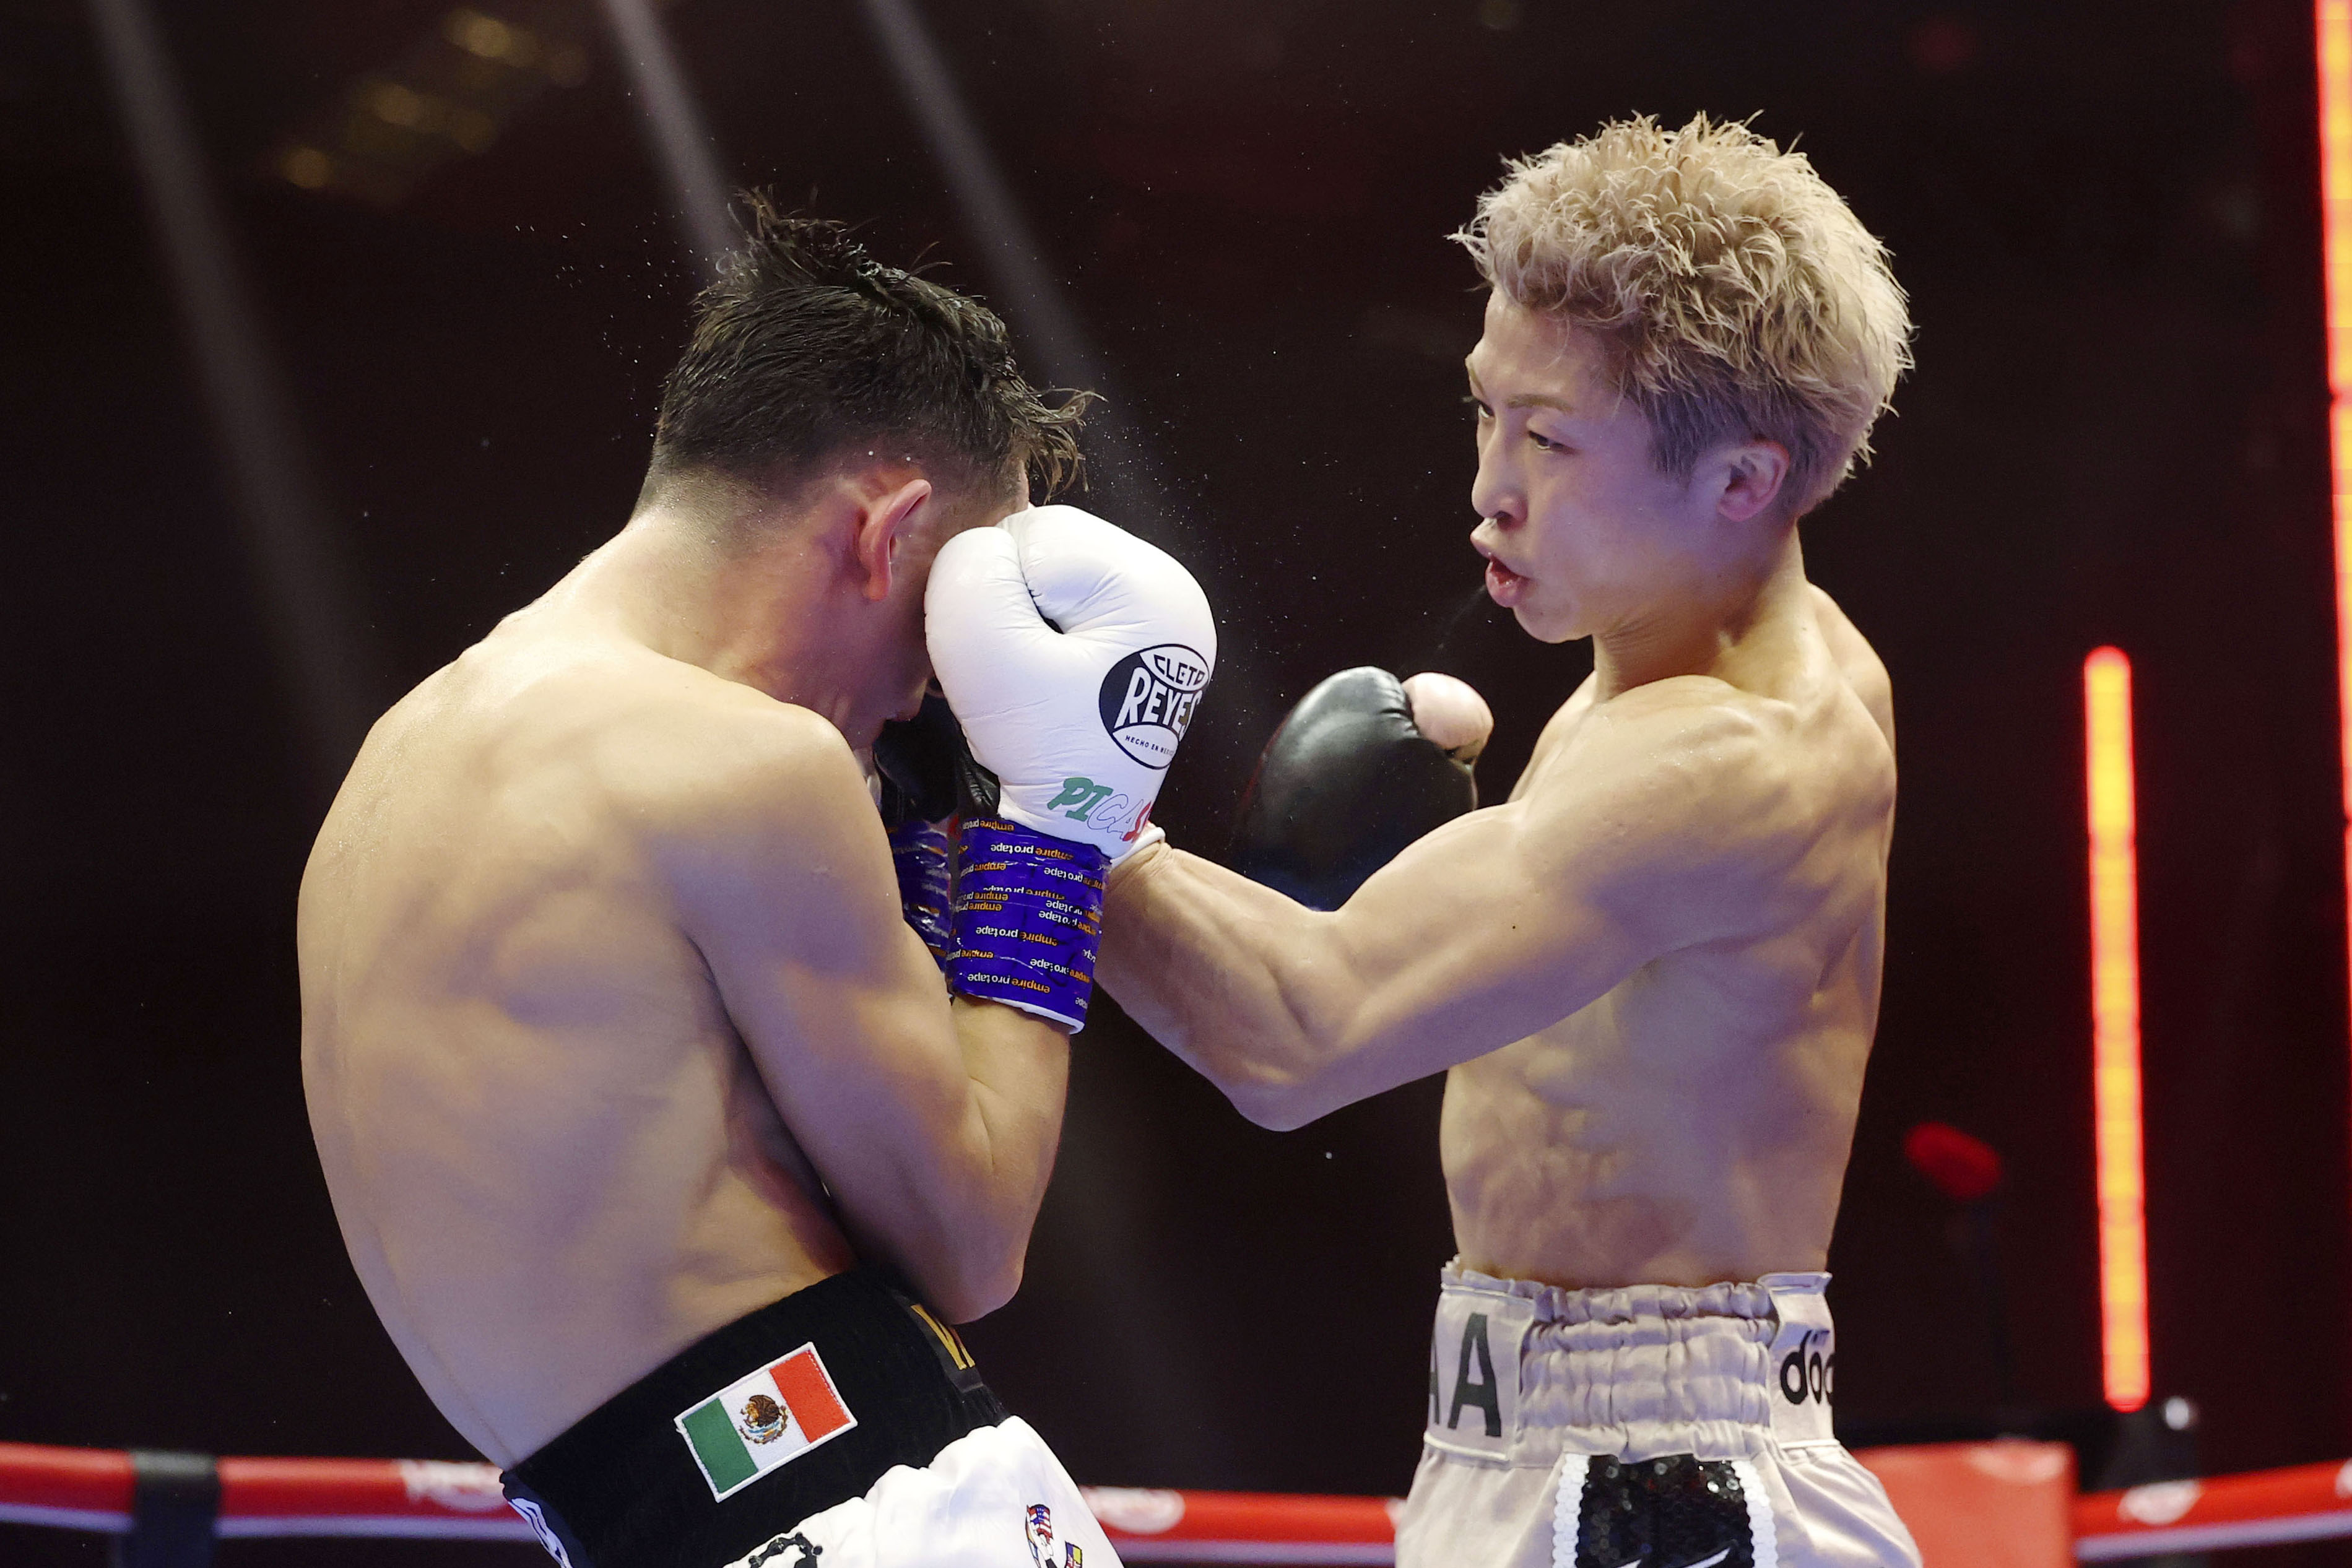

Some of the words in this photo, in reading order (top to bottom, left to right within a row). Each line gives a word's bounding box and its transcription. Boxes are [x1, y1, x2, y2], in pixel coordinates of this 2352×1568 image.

[1114, 666, 1203, 742] REYES
[1125, 735, 1149, 748] HECHO
[1152, 743, 1158, 752] EN
[1047, 777, 1154, 844] PICAS
[991, 842, 1013, 854] tape
[1014, 845, 1035, 854] pro
[1043, 867, 1067, 880] tape
[1067, 872, 1083, 883] pro
[974, 891, 1009, 901] empire
[968, 901, 1002, 912] empire
[1045, 899, 1068, 913] tape
[1038, 910, 1062, 924] tape
[975, 925, 999, 937] tape
[999, 928, 1019, 938] pro
[1020, 931, 1059, 946] empire
[961, 949, 994, 959] empire
[1030, 958, 1053, 972] tape
[967, 972, 991, 984] tape
[1011, 977, 1051, 994] empire
